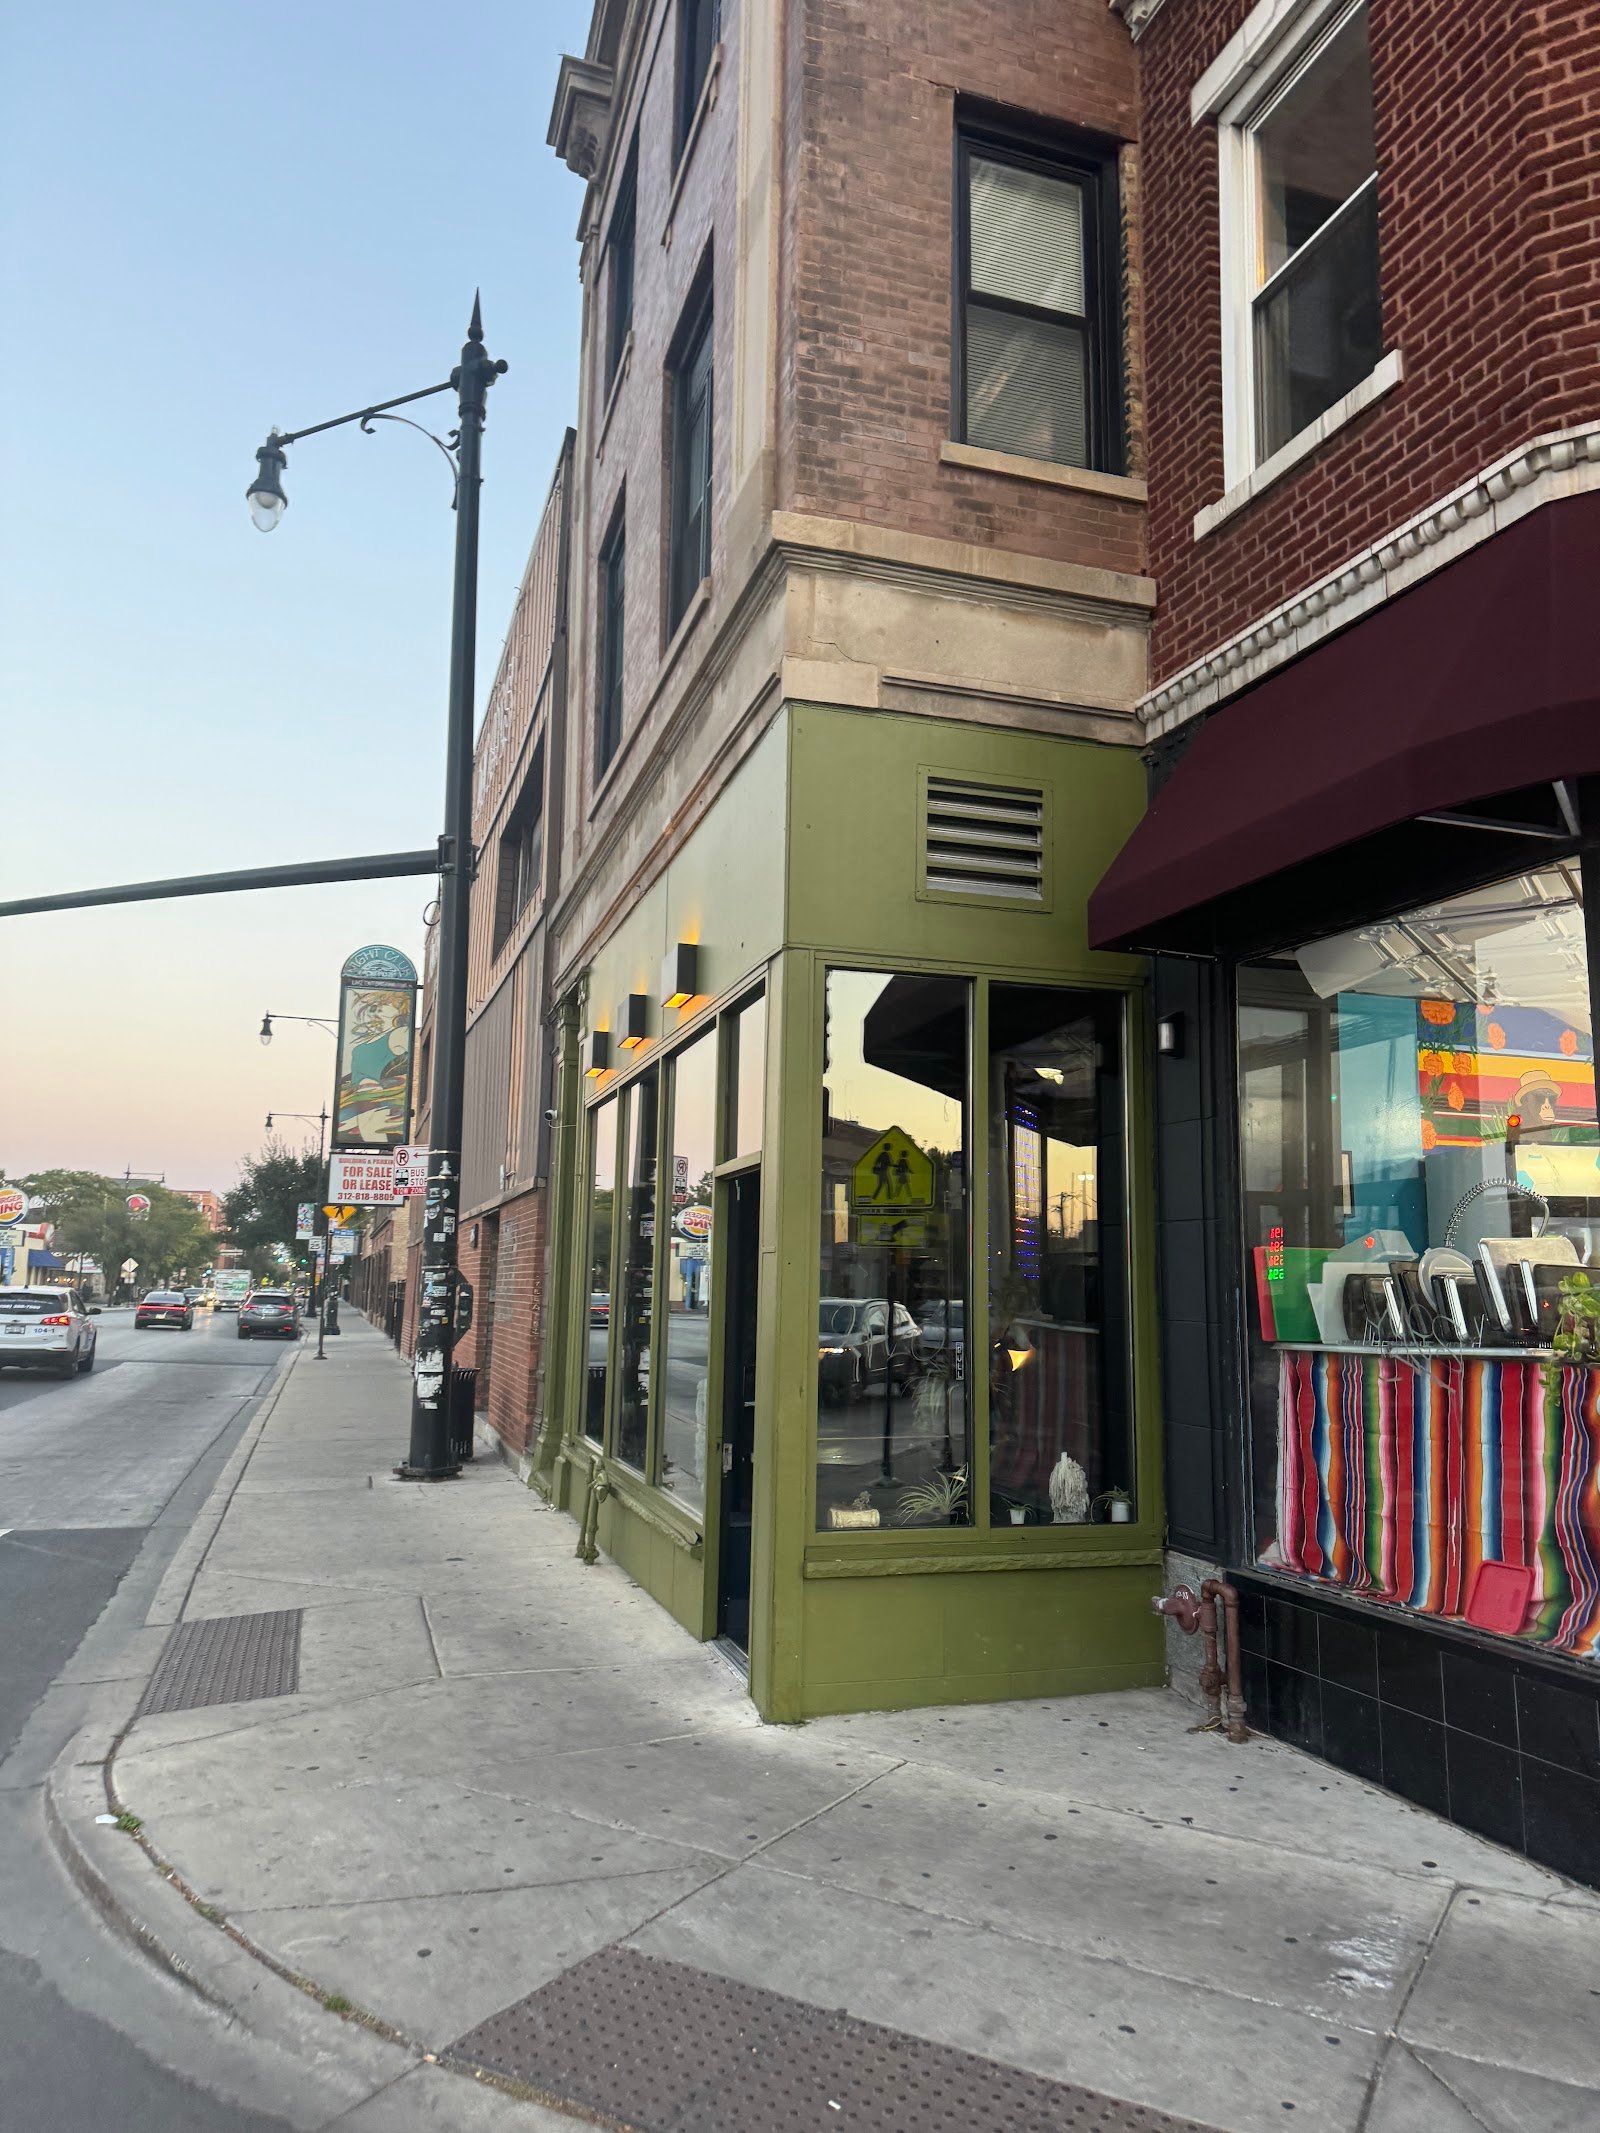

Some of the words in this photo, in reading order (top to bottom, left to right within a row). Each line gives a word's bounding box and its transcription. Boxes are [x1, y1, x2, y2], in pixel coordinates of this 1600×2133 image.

[342, 949, 381, 974] NIGHT
[343, 1166, 364, 1177] FOR
[366, 1167, 392, 1178] SALE
[410, 1169, 425, 1177] BUS
[342, 1179, 357, 1190] OR
[359, 1180, 391, 1191] LEASE
[0, 1194, 23, 1203] RGER
[0, 1201, 23, 1214] ING
